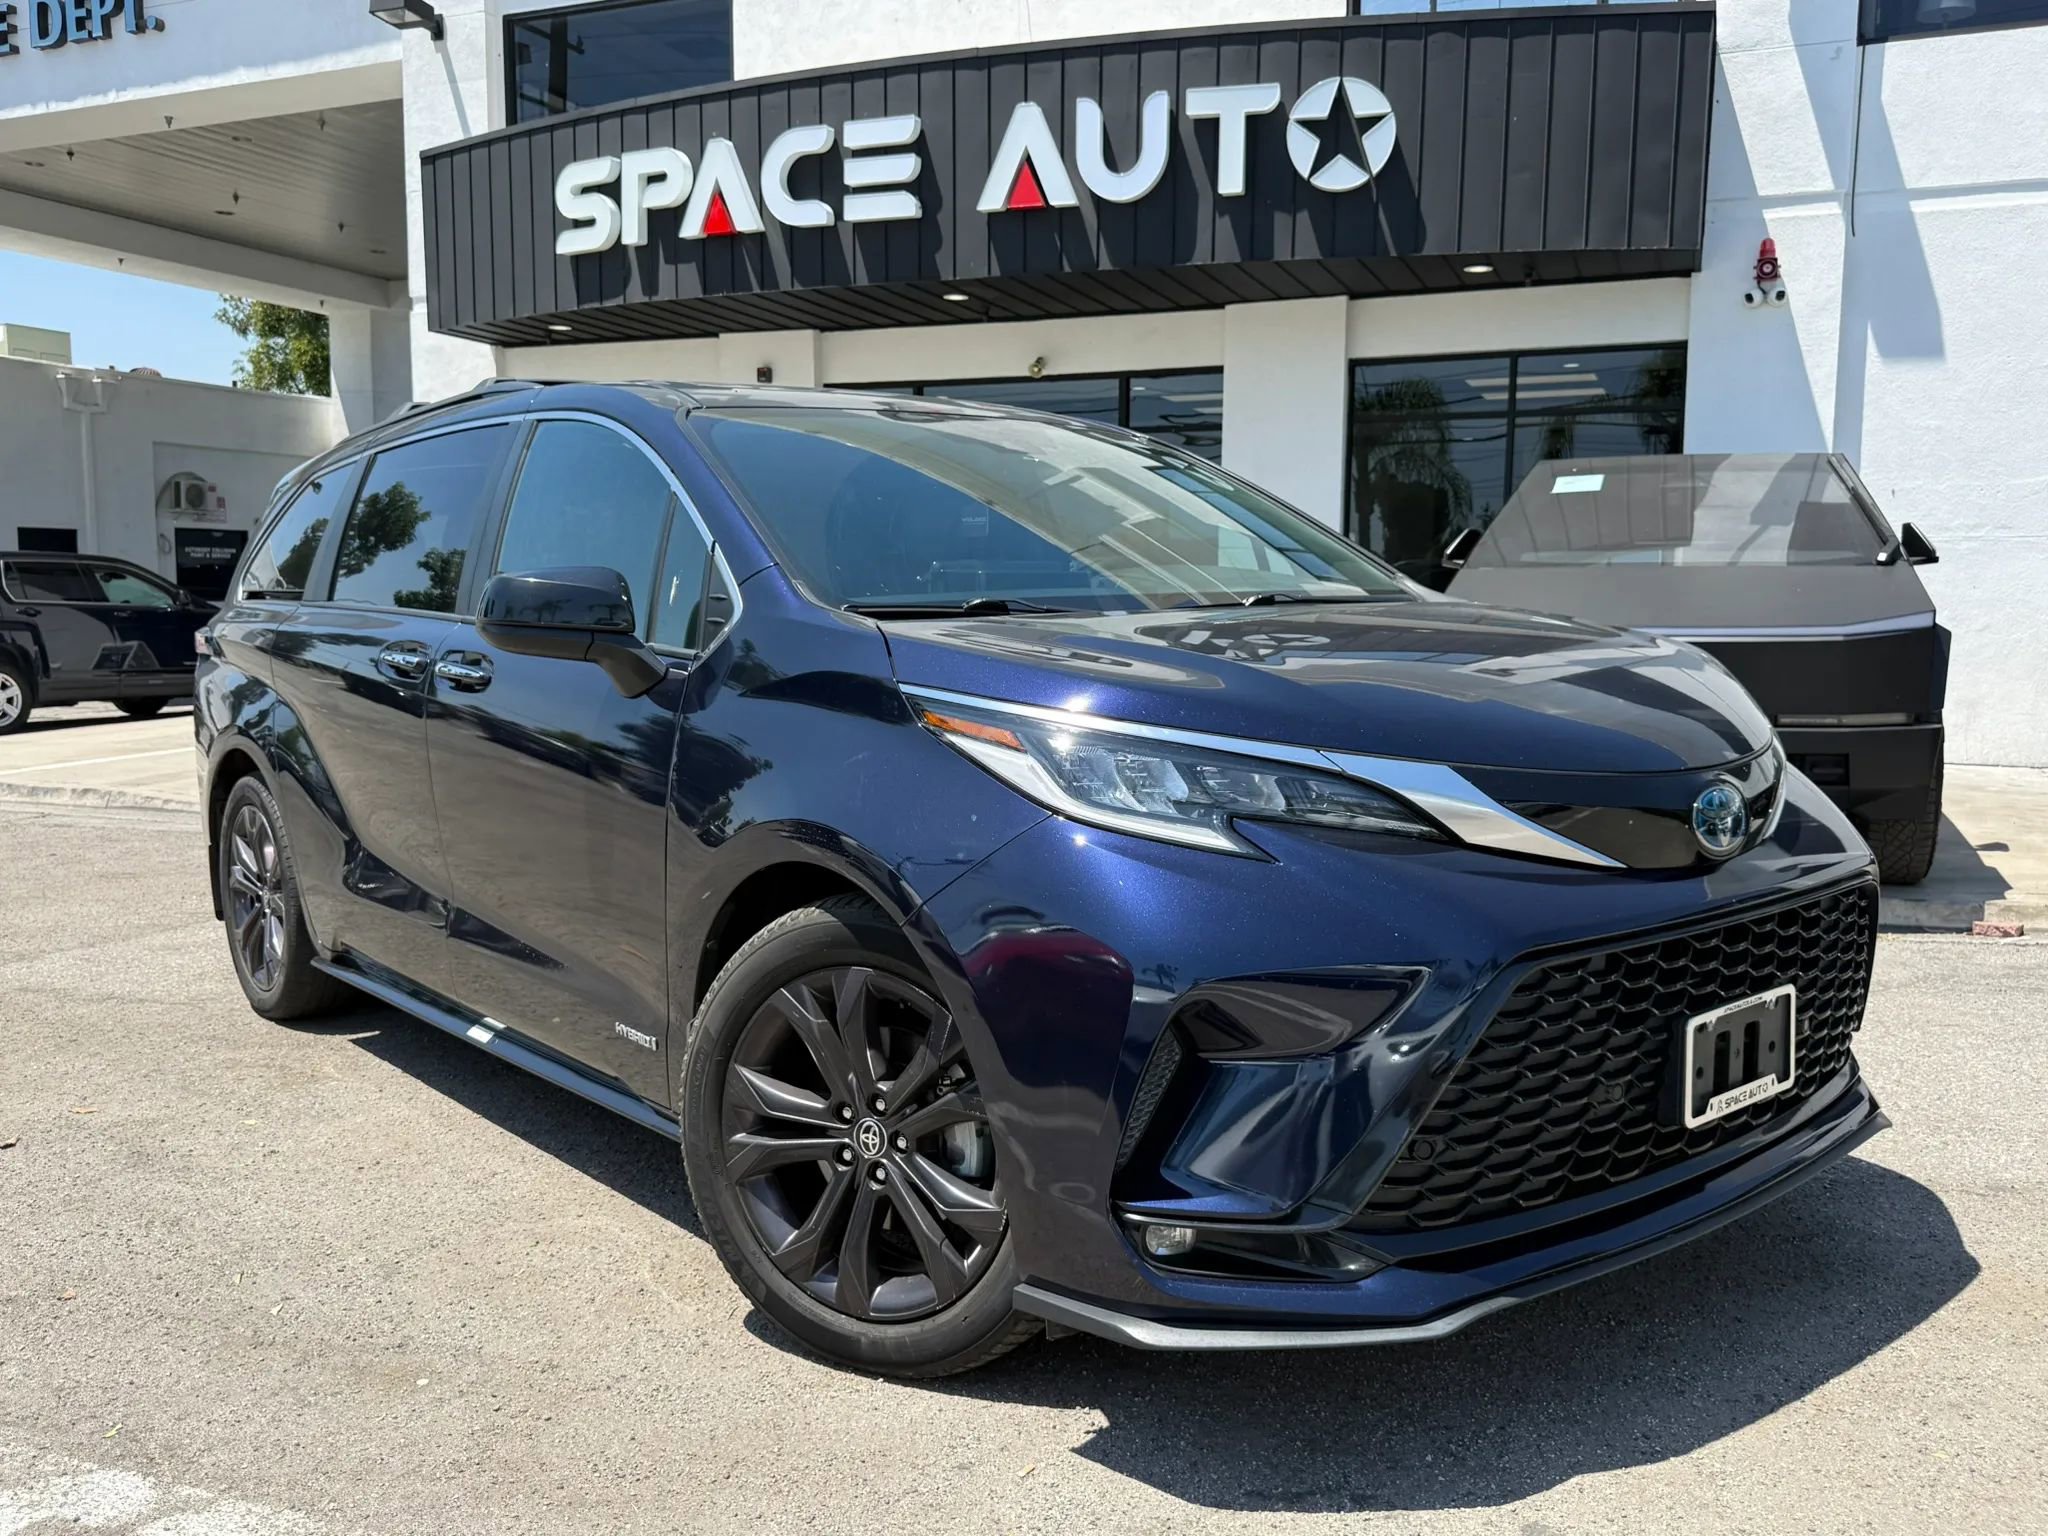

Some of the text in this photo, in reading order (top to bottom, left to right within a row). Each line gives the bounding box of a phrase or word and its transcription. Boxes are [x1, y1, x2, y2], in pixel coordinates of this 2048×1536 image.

[555, 76, 1399, 257] SPACE AUTO
[615, 1021, 657, 1051] HYBRID
[1724, 1082, 1769, 1109] SPACE AUTO
